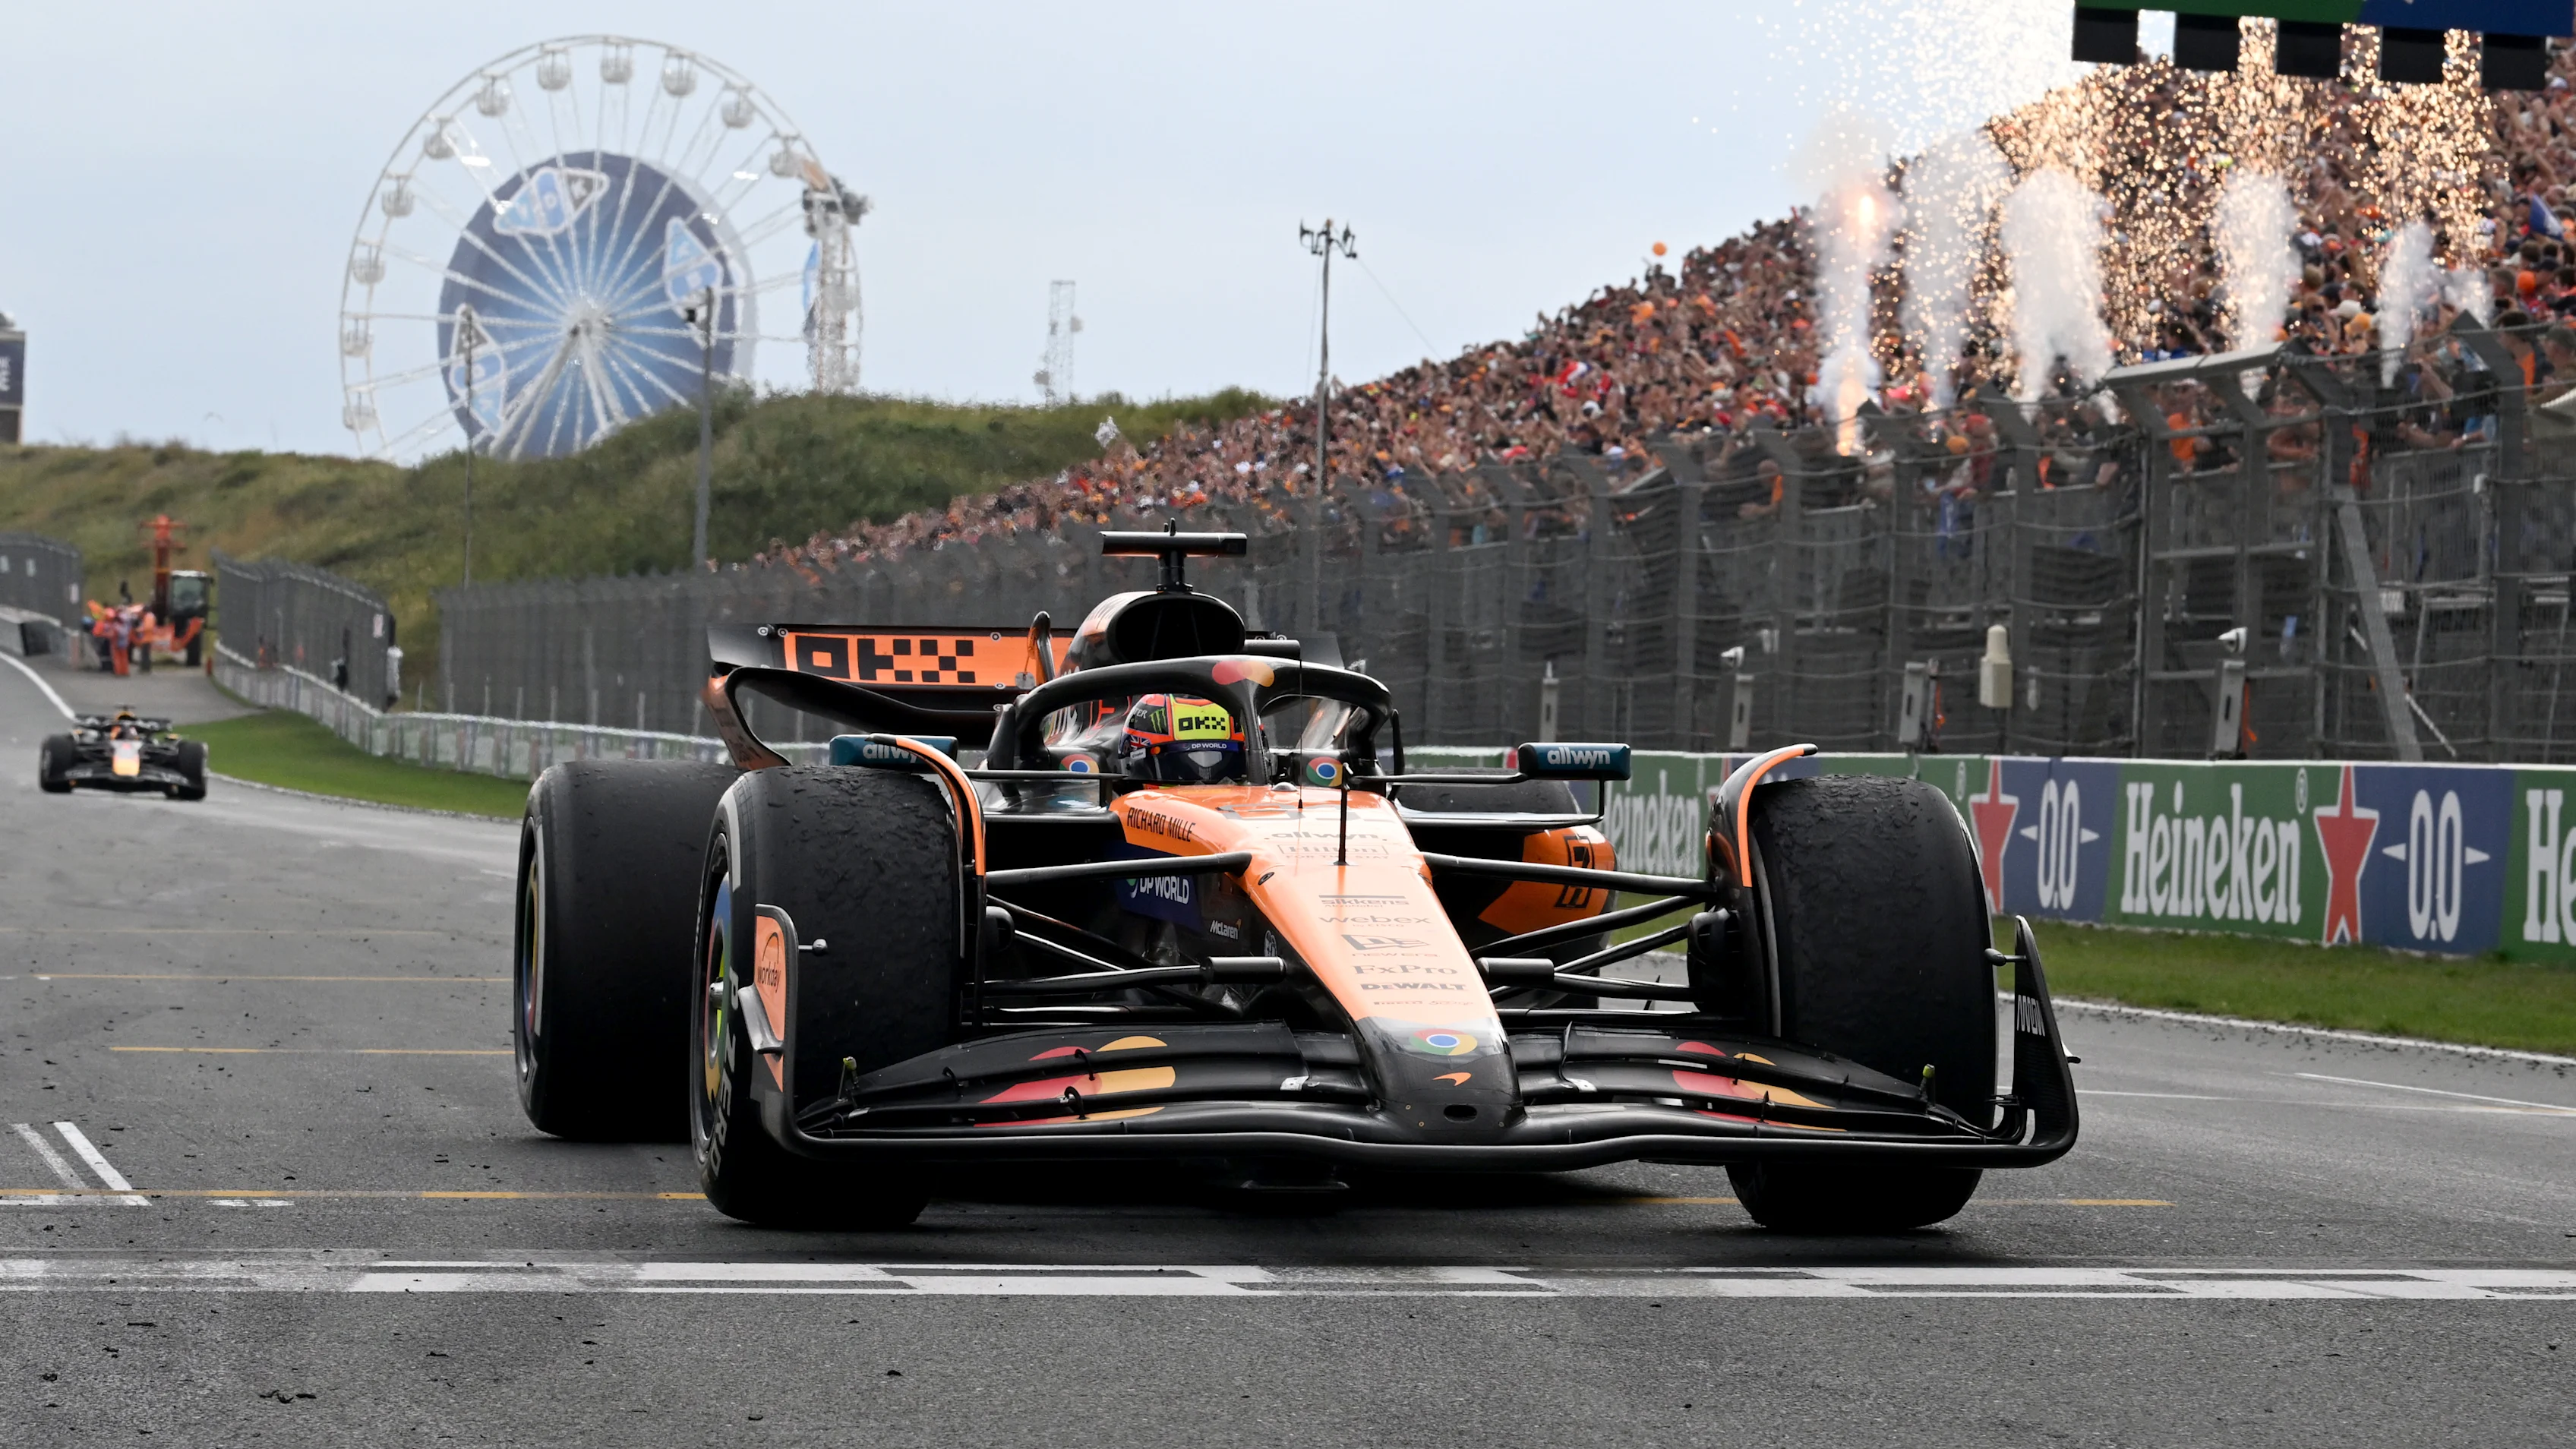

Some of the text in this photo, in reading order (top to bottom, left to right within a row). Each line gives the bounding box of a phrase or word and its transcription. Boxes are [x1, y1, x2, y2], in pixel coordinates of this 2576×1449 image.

[1179, 716, 1226, 731] OKX
[1547, 747, 1611, 769] allwyn
[1127, 807, 1196, 842] RICHARD MILLE
[2121, 781, 2301, 925] Heineken
[2408, 788, 2463, 943] 0.0
[1140, 876, 1190, 904] DP WORLD
[1210, 920, 1239, 940] McLaren
[1318, 915, 1433, 923] webex
[757, 961, 781, 993] workday
[1352, 964, 1458, 975] FxPro
[709, 1023, 737, 1178] ZERO
